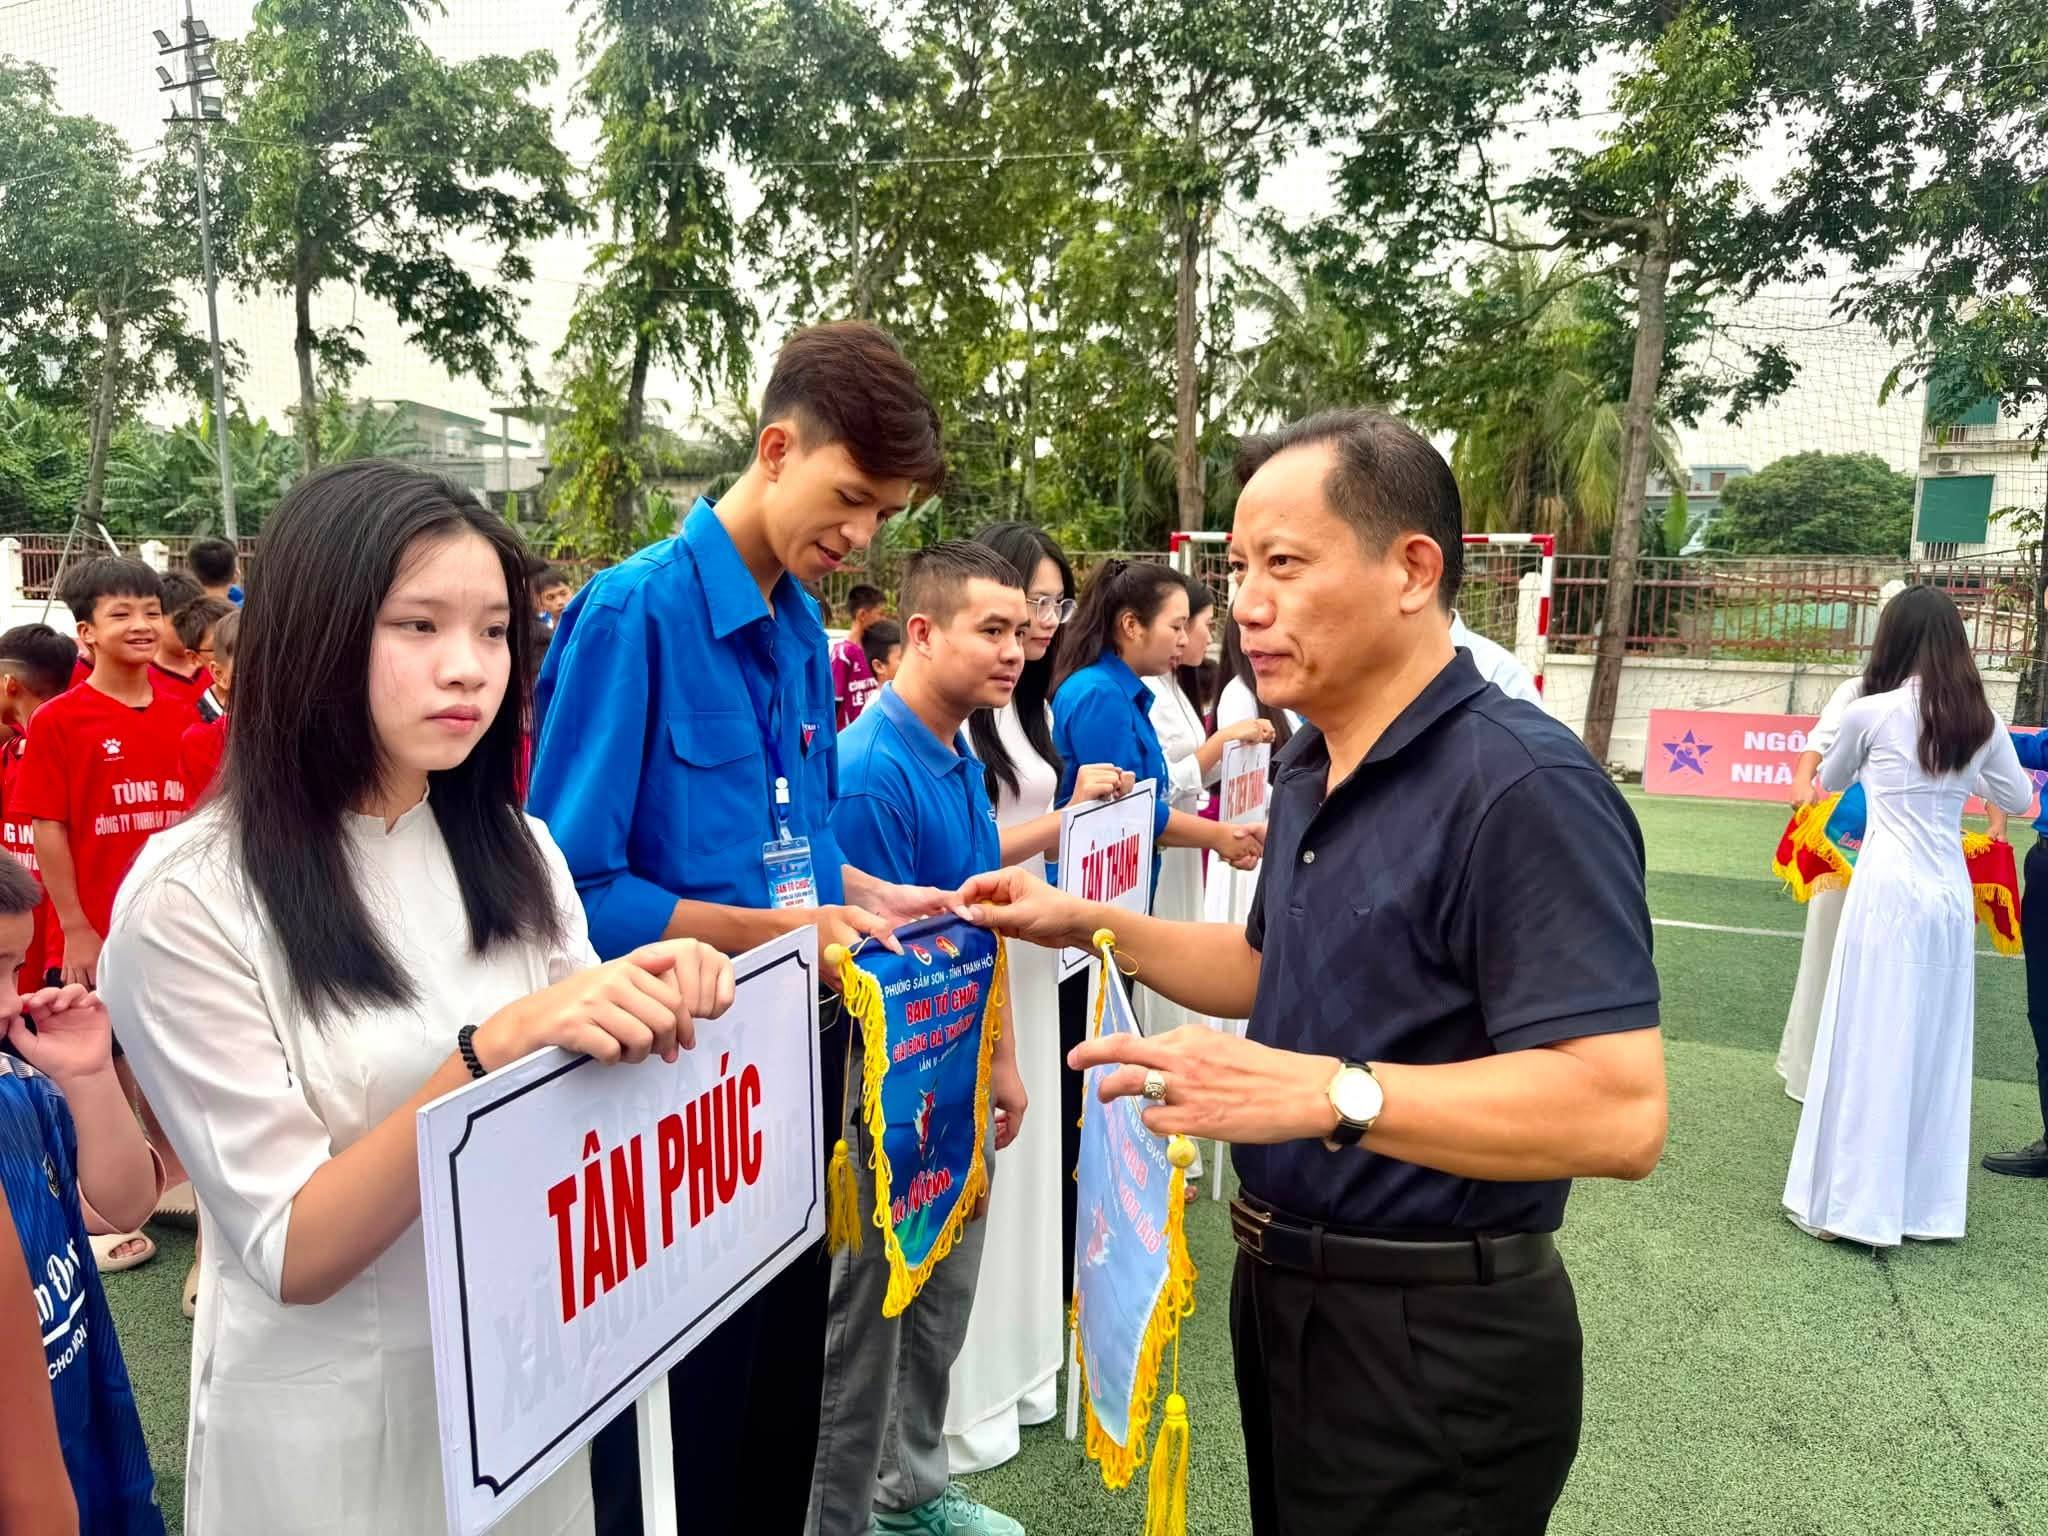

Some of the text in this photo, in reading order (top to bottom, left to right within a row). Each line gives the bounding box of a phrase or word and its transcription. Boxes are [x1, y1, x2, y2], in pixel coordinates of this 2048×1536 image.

[112, 778, 159, 805] TÙNG
[1731, 763, 1793, 785] NHÀ
[95, 812, 120, 836] CÔNG
[119, 814, 130, 833] TY
[1082, 840, 1104, 902] TÂN
[884, 978, 911, 999] PHƯỜNG
[962, 959, 981, 976] THANH
[905, 980, 979, 1027] BAN TỔ CHỨC
[908, 1032, 928, 1056] BÓNG
[930, 1024, 943, 1048] ĐÁ
[547, 1129, 648, 1325] TÂN
[657, 1051, 764, 1249] PHÚC
[906, 1168, 953, 1219] Niệm
[48, 1348, 74, 1381] CHO
